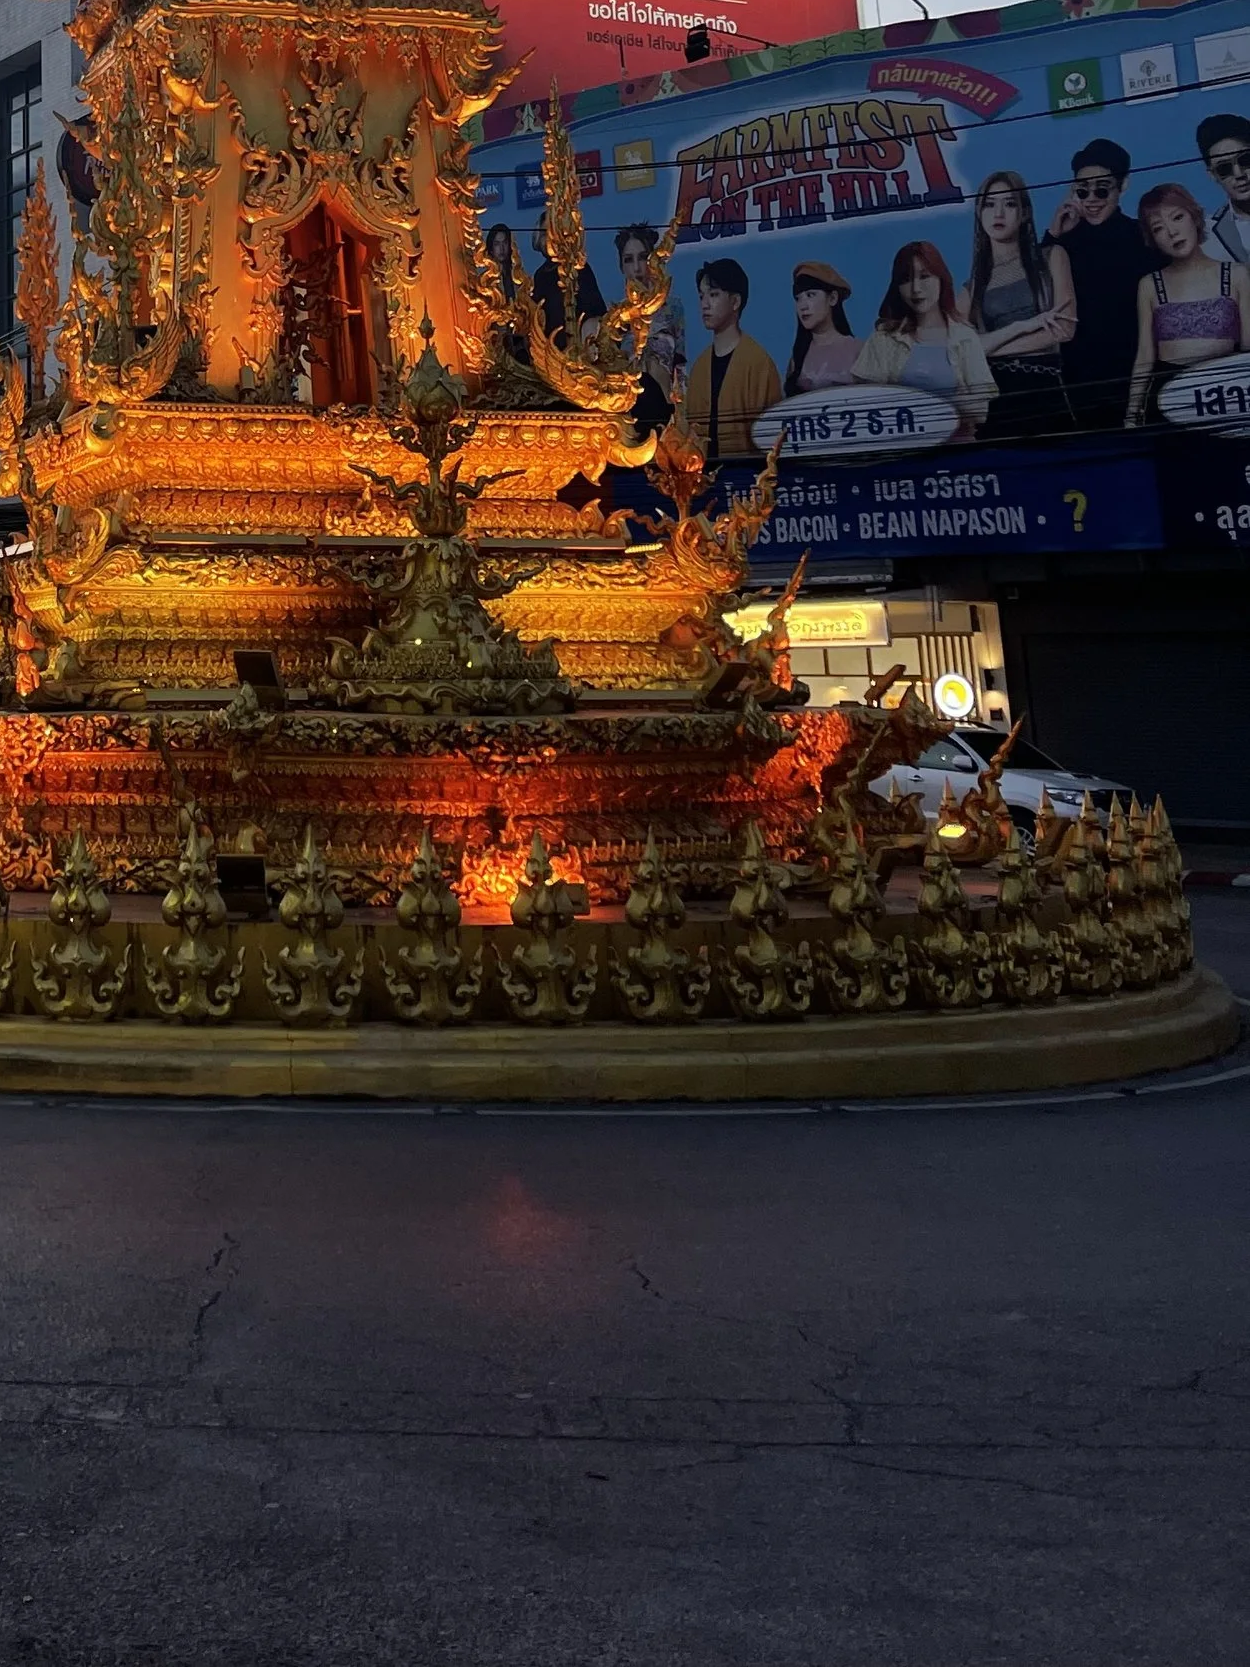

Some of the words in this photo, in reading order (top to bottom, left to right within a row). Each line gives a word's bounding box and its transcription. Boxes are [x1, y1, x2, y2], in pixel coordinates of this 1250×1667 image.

[877, 63, 999, 107] กลับมาแล้ว!!!
[676, 99, 965, 245] FARMFEST
[700, 191, 749, 240] ON
[752, 174, 827, 232] THE
[827, 170, 925, 221] HILL
[839, 410, 857, 438] 2
[1194, 385, 1250, 417] เสา
[775, 514, 838, 544] BACON
[858, 510, 918, 540] BEAN
[922, 506, 1027, 537] NAPASON
[1062, 489, 1088, 533] ?
